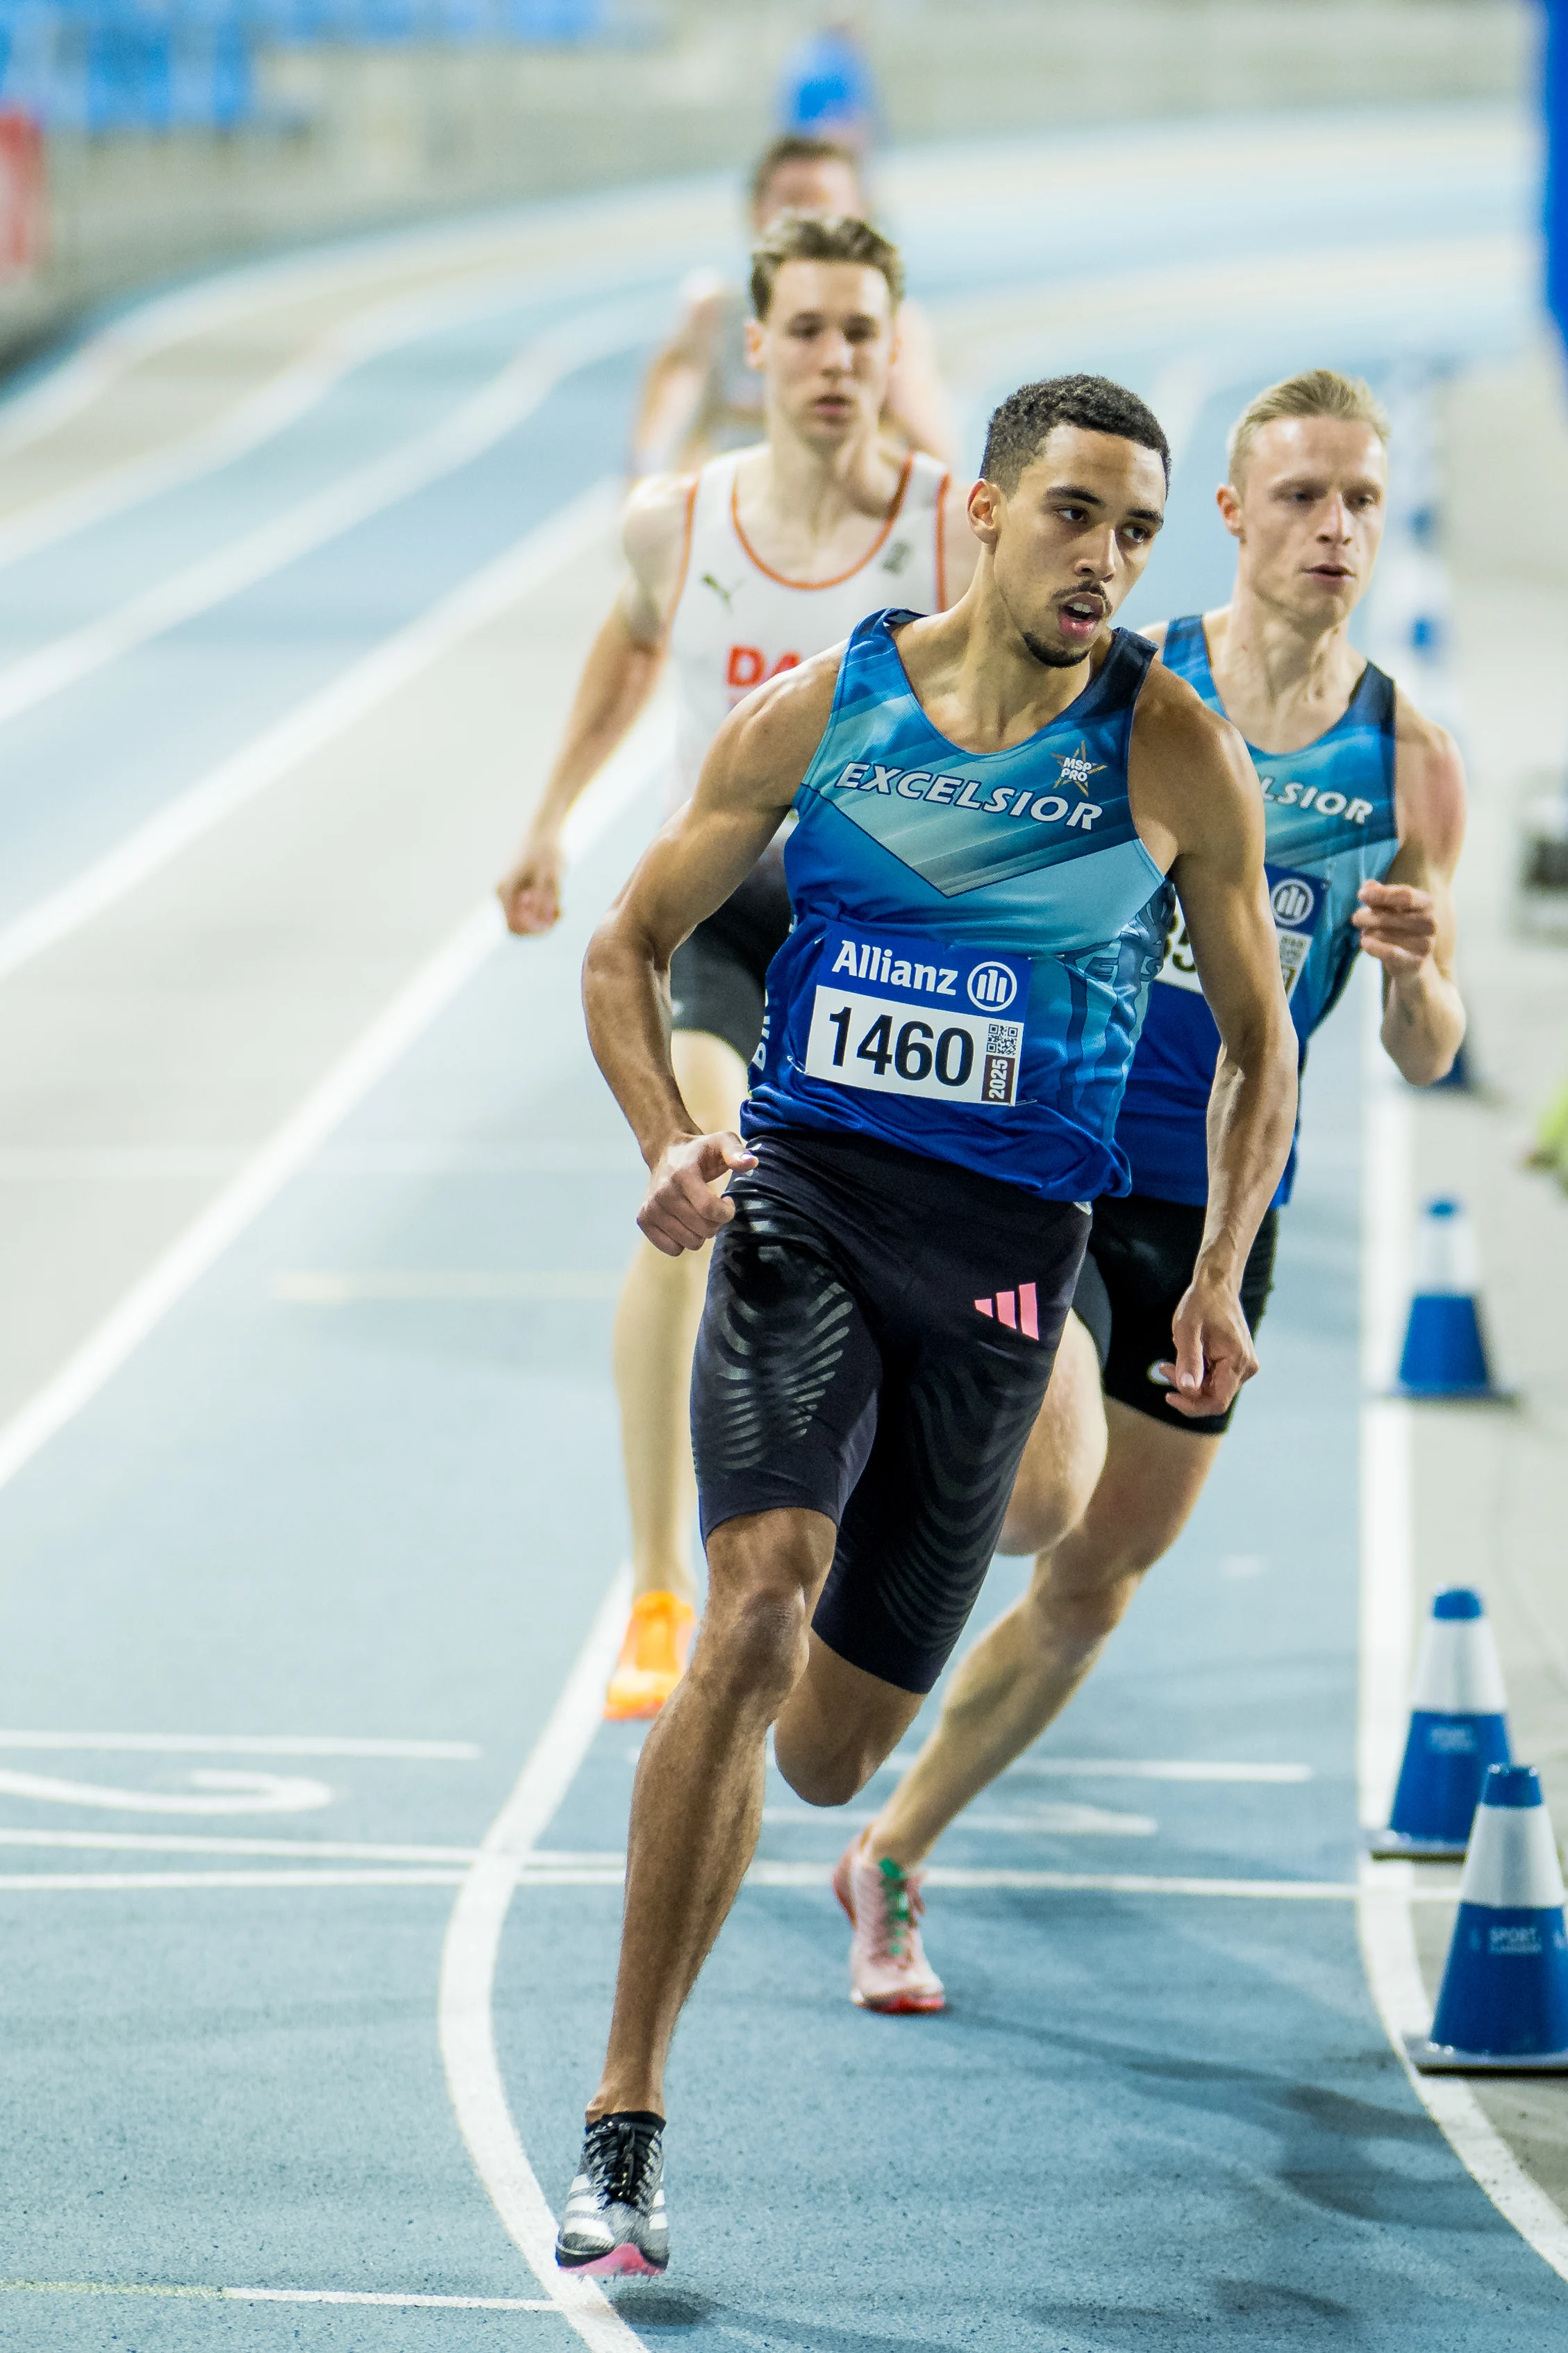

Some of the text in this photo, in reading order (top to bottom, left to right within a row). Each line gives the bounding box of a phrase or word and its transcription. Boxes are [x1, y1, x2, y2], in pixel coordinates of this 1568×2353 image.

[1060, 767, 1087, 782] PRO
[1062, 757, 1092, 772] MSP
[835, 761, 1103, 831] EXCELSIOR
[1258, 774, 1374, 825] LSIOR
[832, 940, 958, 996] Allianz
[828, 1006, 974, 1088] 1460
[988, 1058, 1008, 1100] 2025
